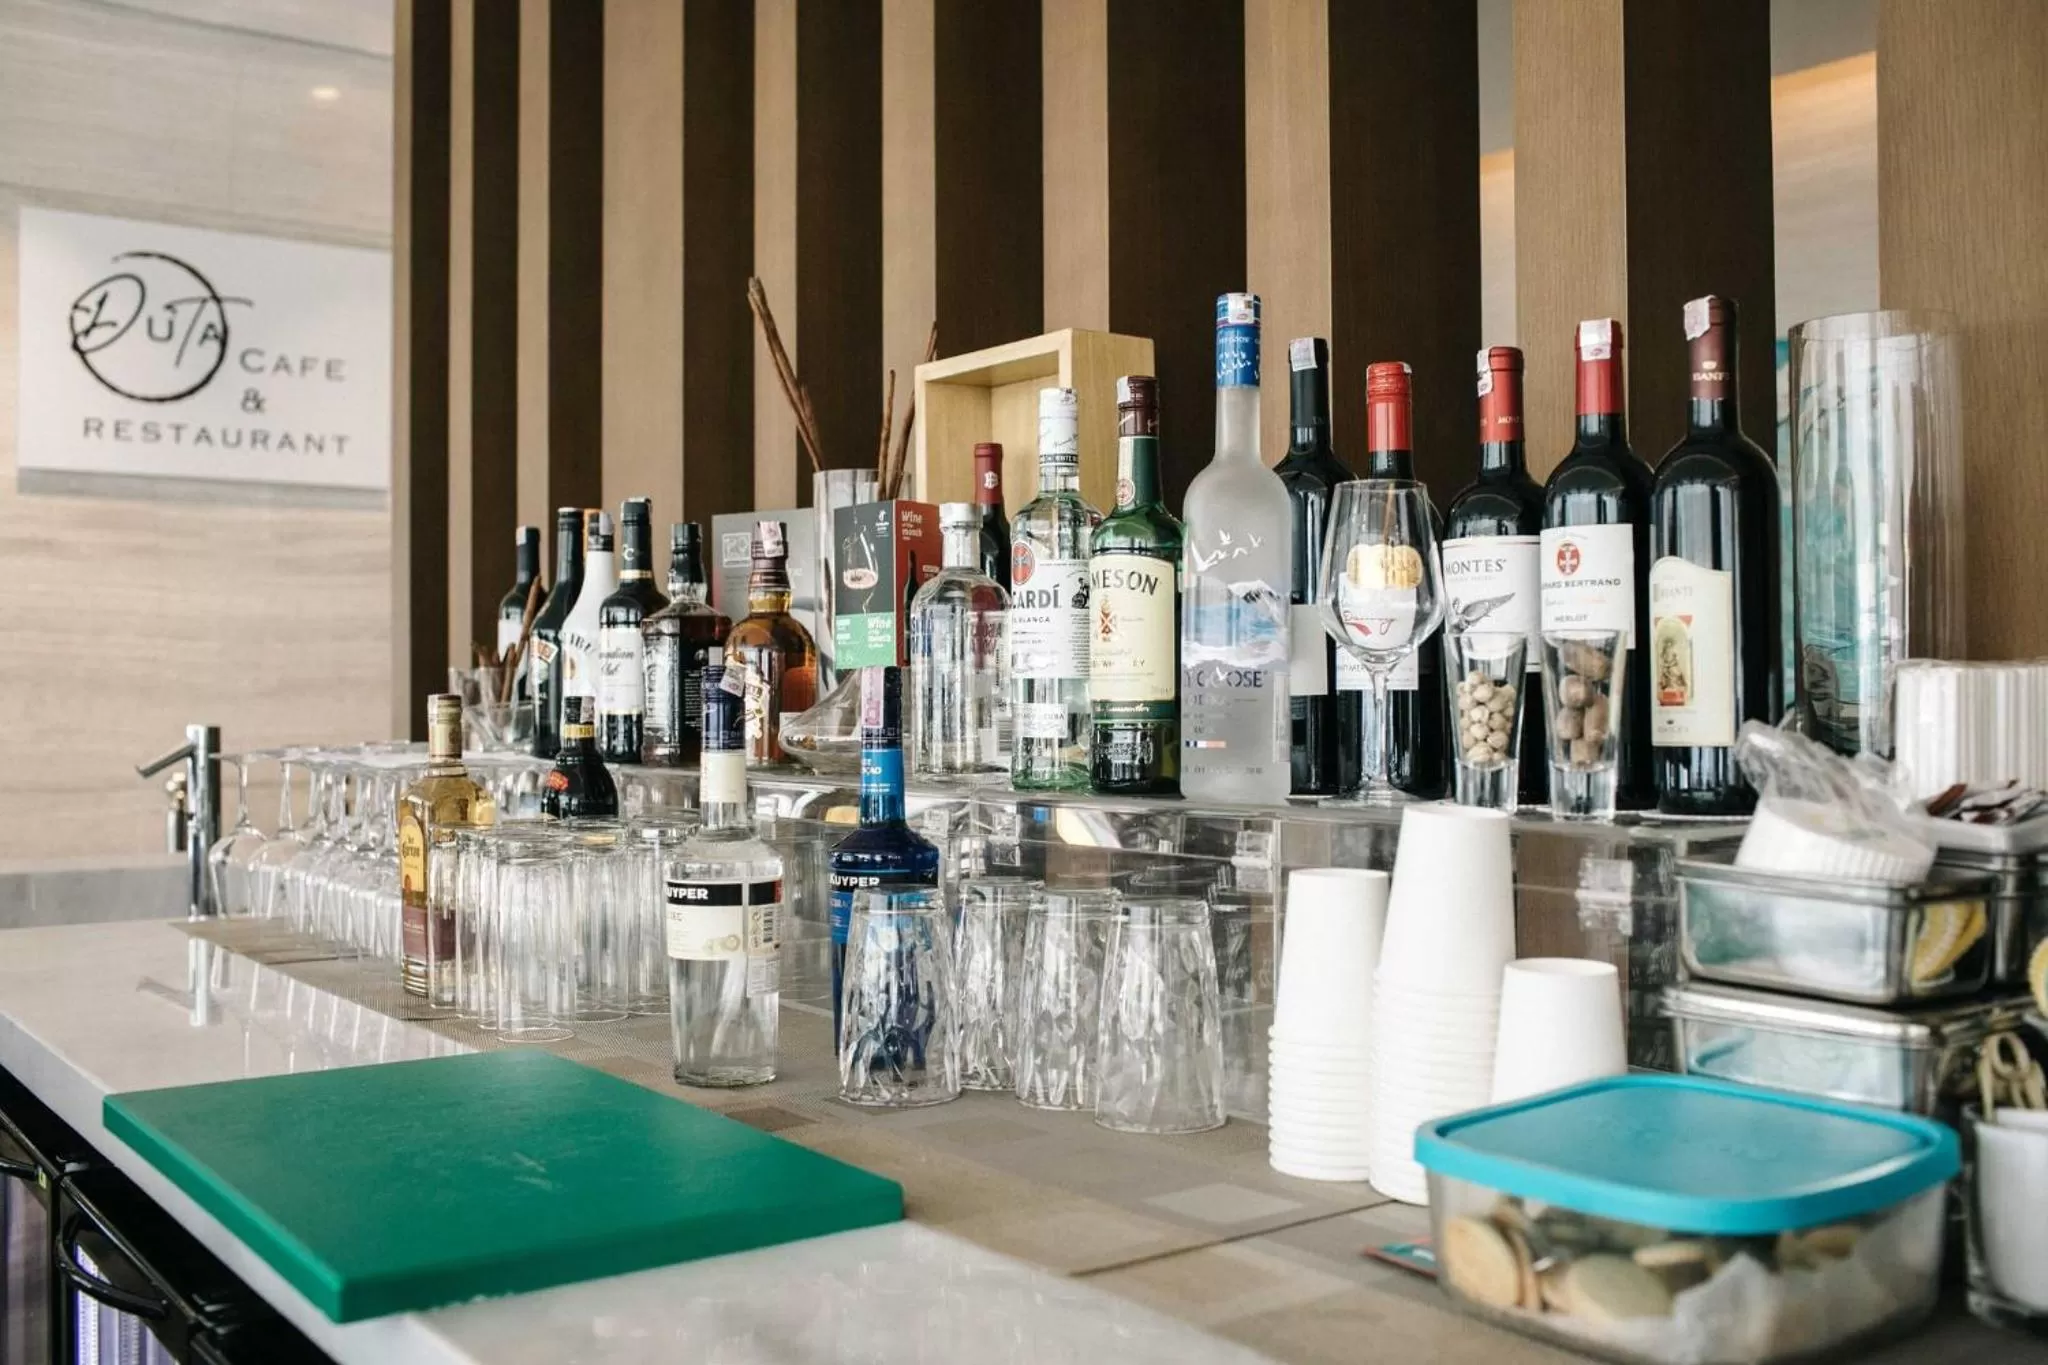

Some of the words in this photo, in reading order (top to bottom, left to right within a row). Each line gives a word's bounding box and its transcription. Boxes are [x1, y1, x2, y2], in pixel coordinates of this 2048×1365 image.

[239, 347, 347, 382] CAFE
[240, 387, 266, 414] &
[82, 416, 352, 456] RESTAURANT
[1564, 577, 1621, 590] BERTRAND
